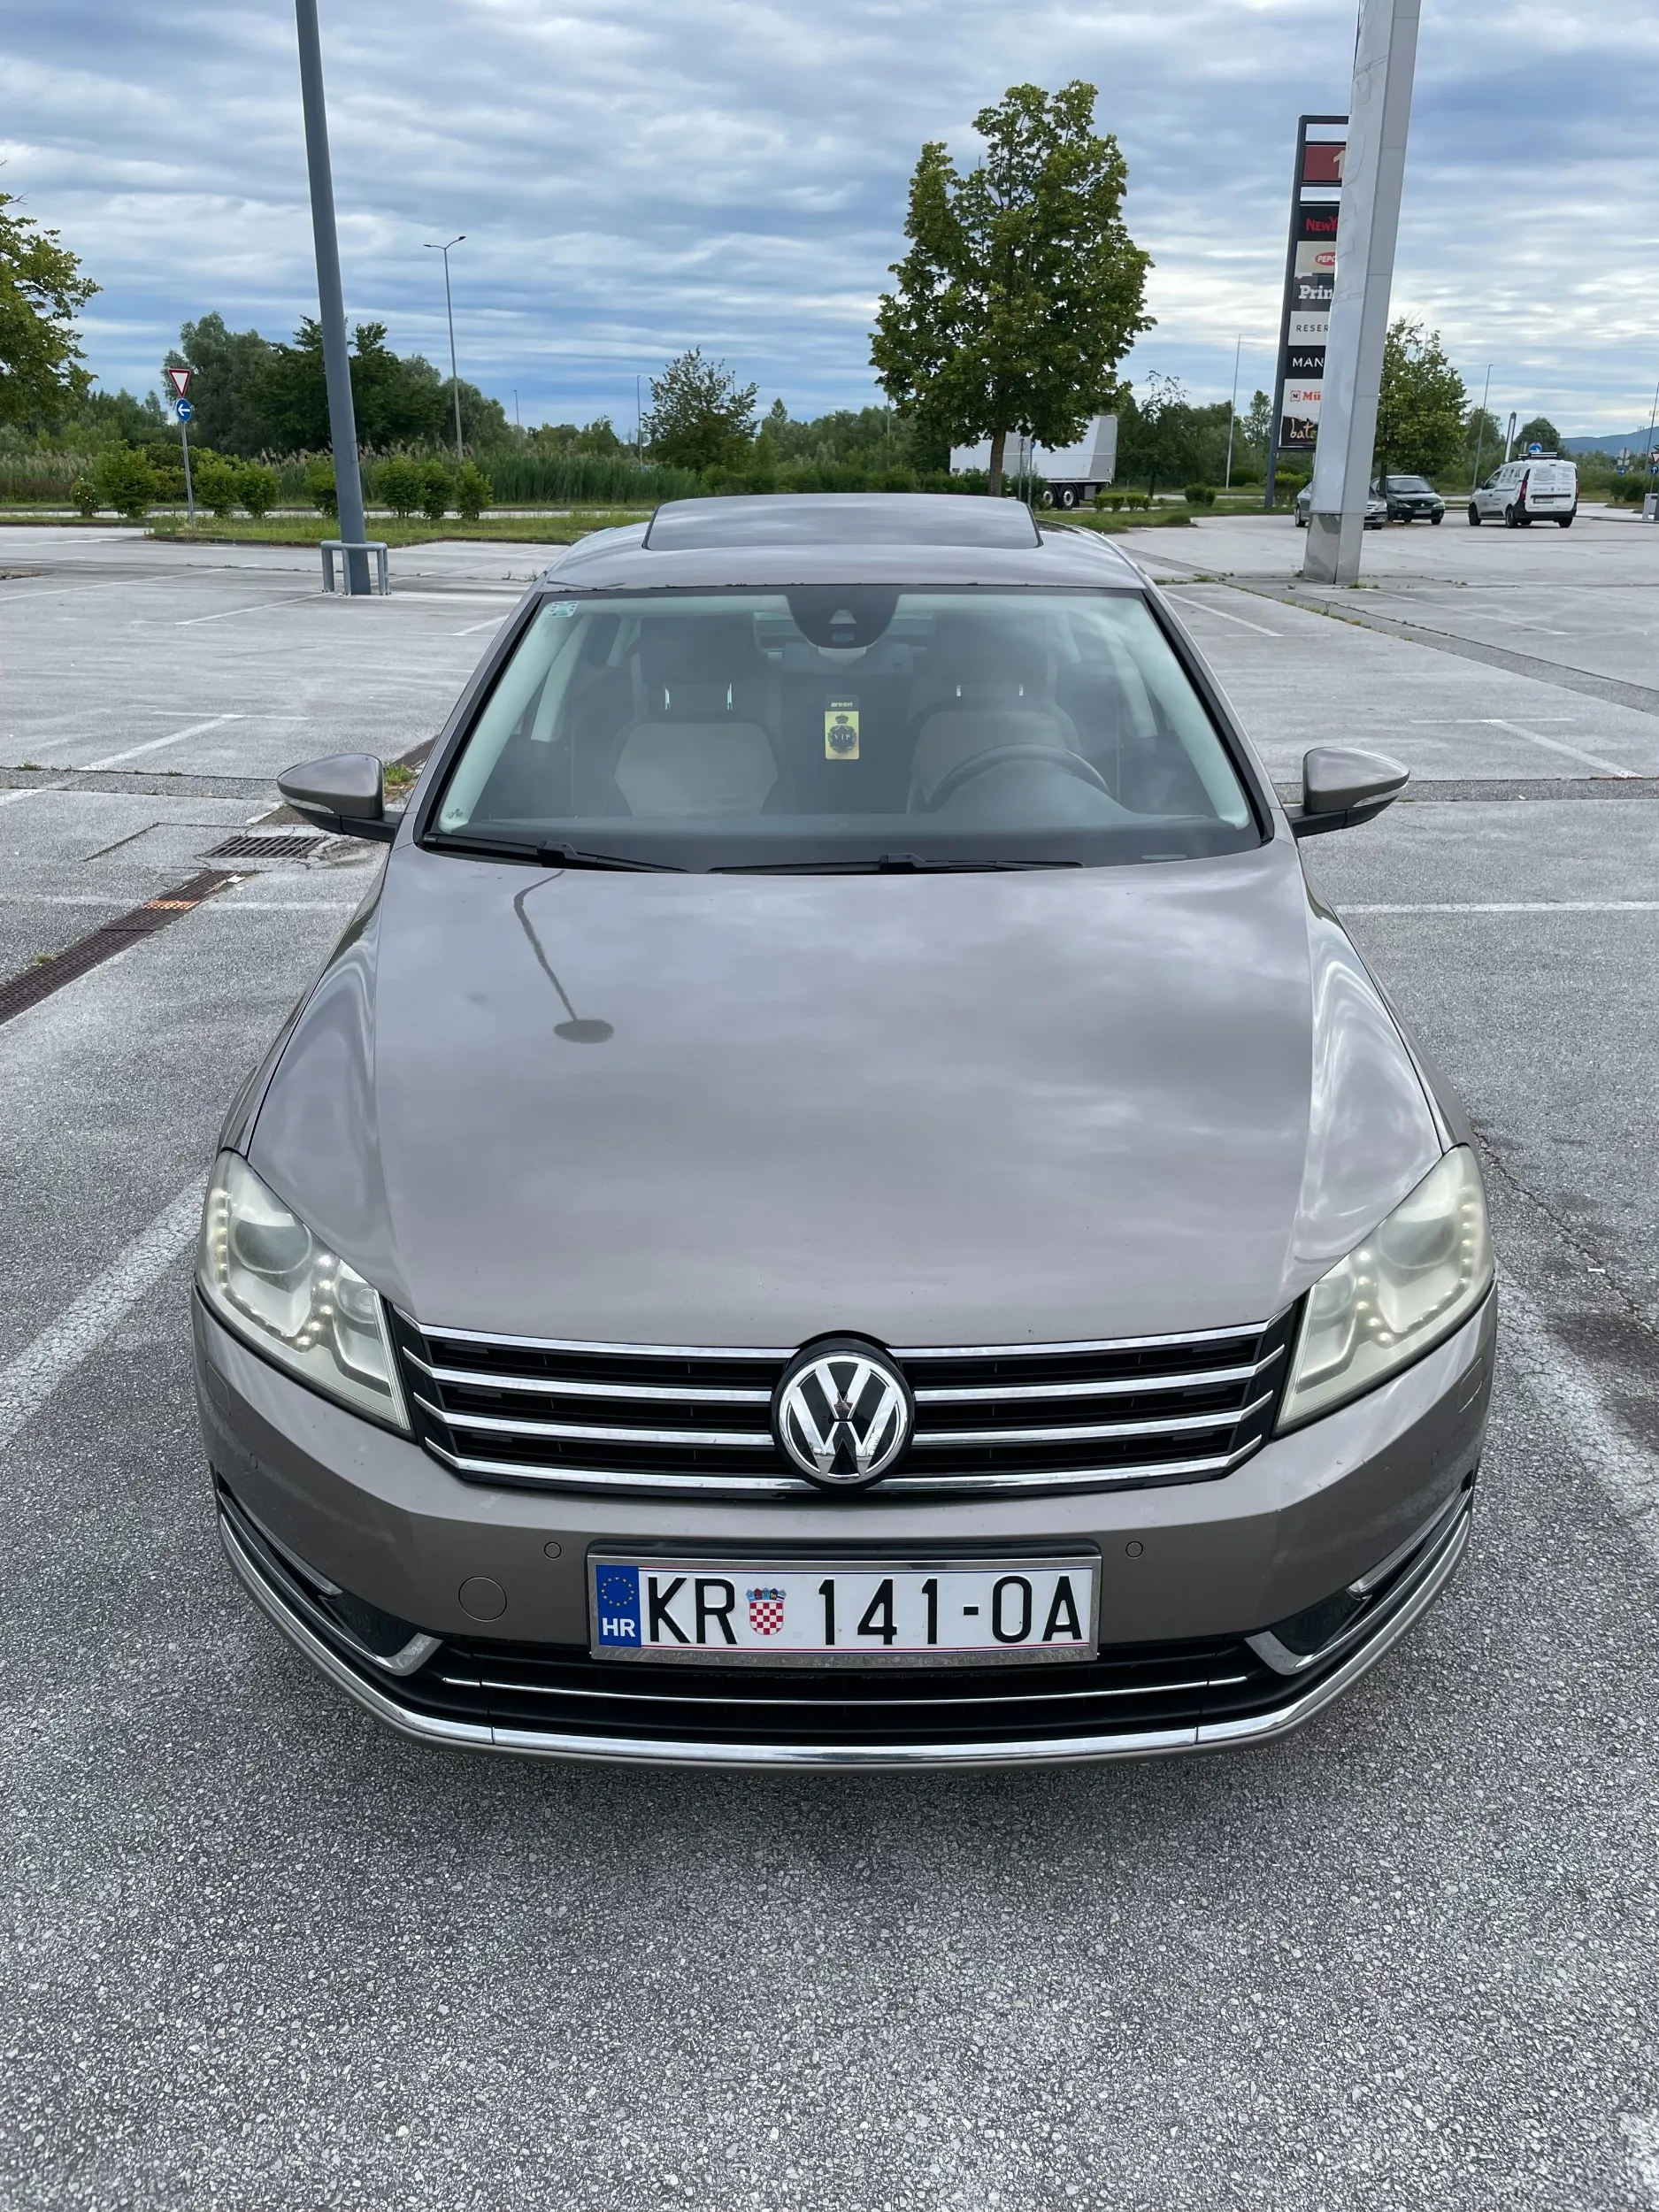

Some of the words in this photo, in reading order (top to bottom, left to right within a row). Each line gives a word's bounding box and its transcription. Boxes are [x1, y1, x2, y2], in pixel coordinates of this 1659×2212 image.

[1292, 357, 1324, 367] MAN
[648, 1577, 738, 1644] KR
[818, 1575, 1083, 1646] 141-OA
[602, 1617, 636, 1638] HR
